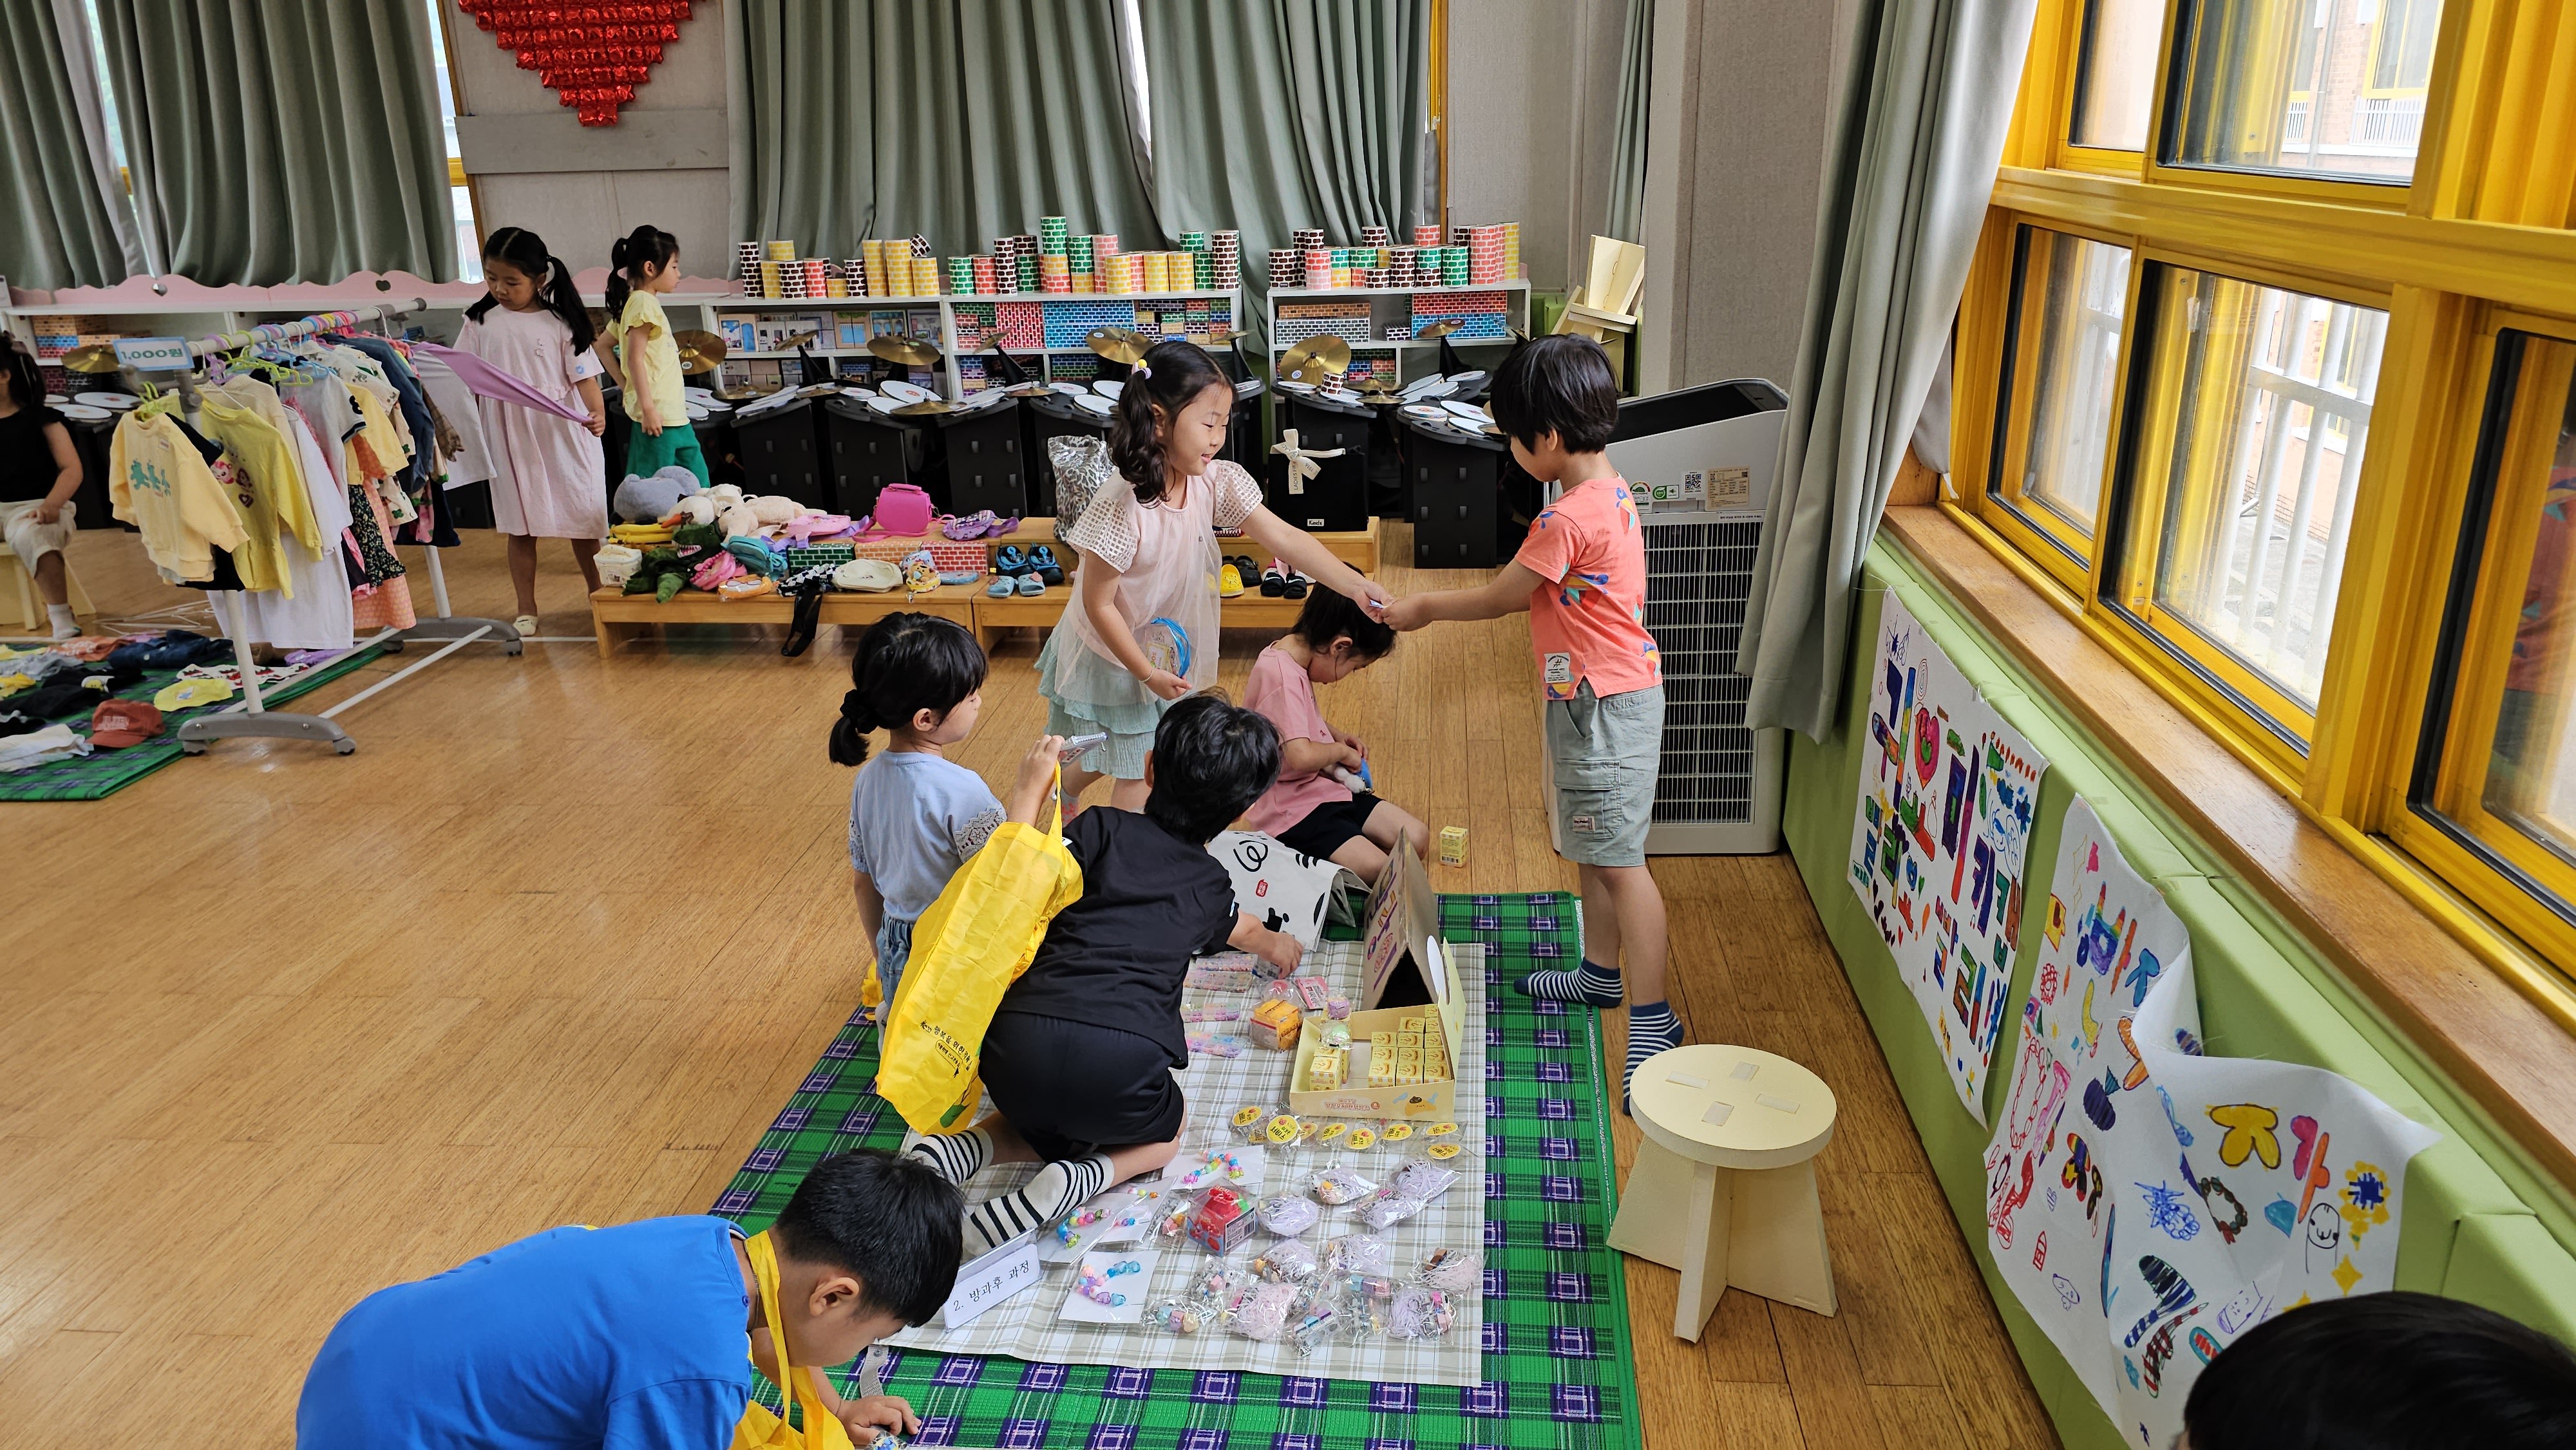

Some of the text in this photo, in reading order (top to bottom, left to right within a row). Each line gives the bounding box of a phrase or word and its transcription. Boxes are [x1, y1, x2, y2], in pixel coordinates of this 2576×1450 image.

[120, 348, 184, 361] 1,000원
[934, 1026, 951, 1044] 행복을
[952, 1040, 965, 1055] 위한
[953, 1260, 1029, 1312] 2. 방과후 과정
